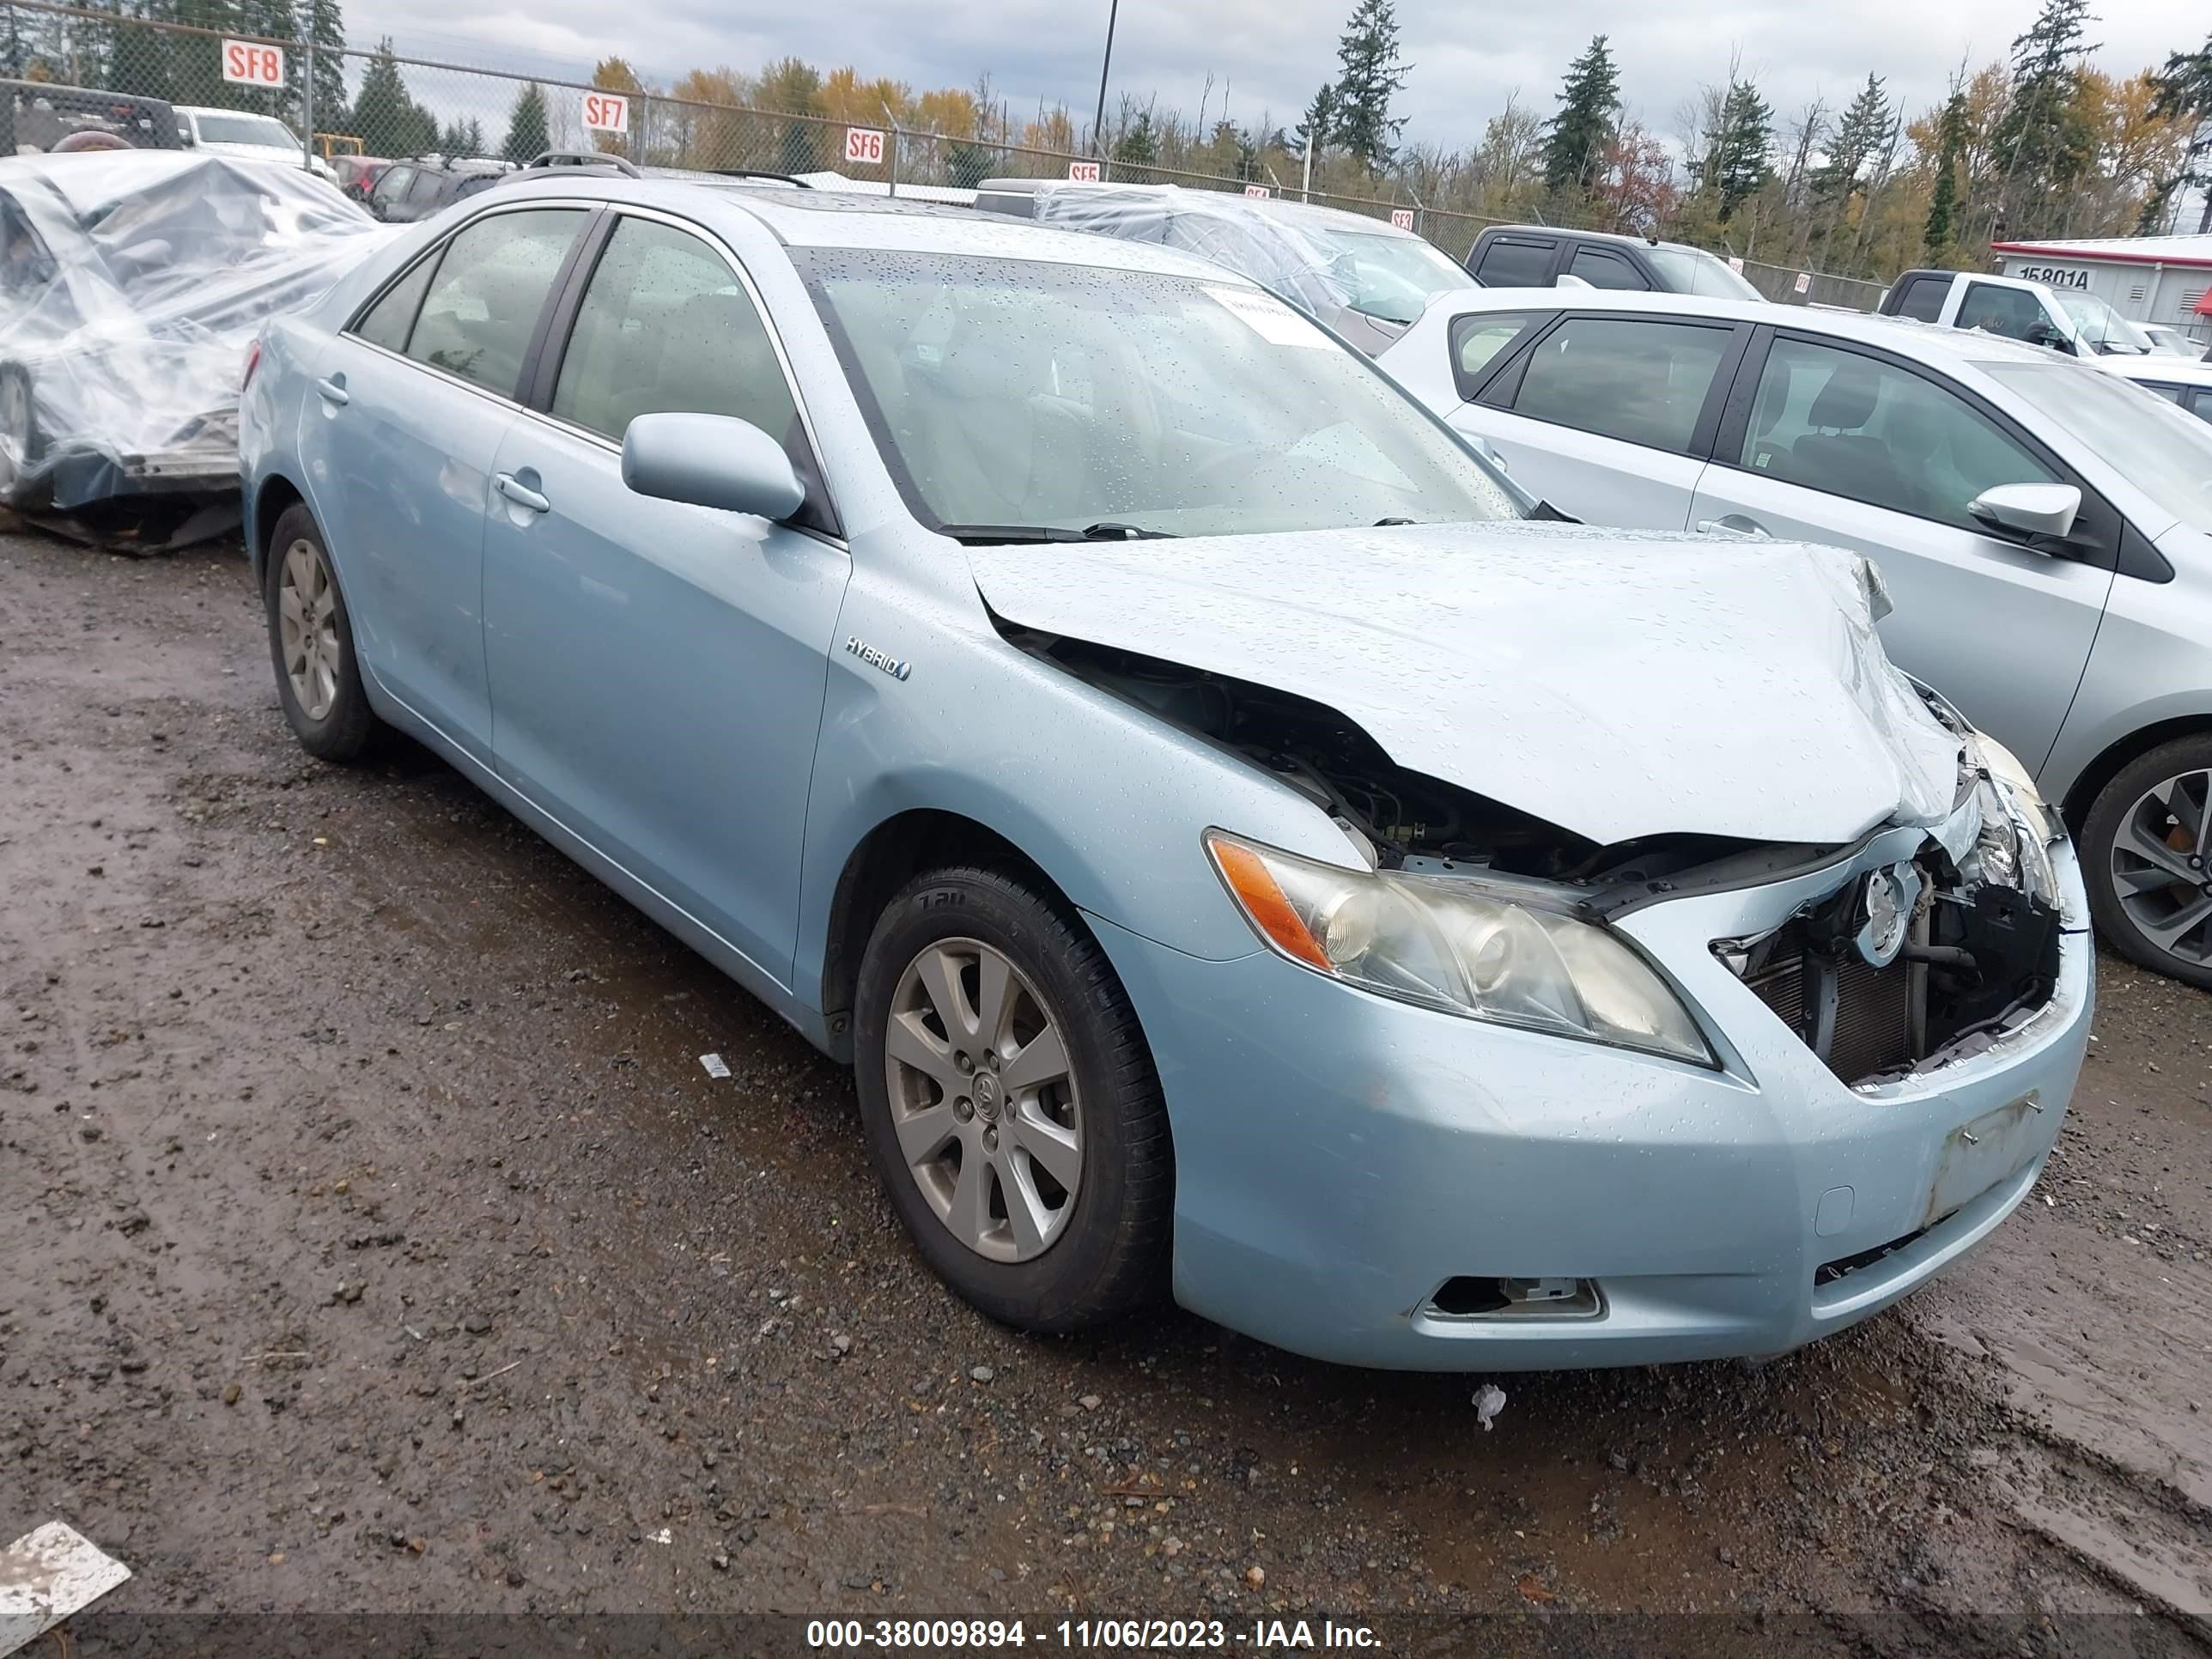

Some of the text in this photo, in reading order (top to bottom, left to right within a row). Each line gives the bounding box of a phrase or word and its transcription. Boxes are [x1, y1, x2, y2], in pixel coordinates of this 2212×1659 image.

[228, 45, 278, 82] SF8
[586, 96, 623, 128] SF7
[849, 132, 880, 159] SF6
[2020, 266, 2088, 290] 15801A
[845, 635, 900, 676] HYBRID
